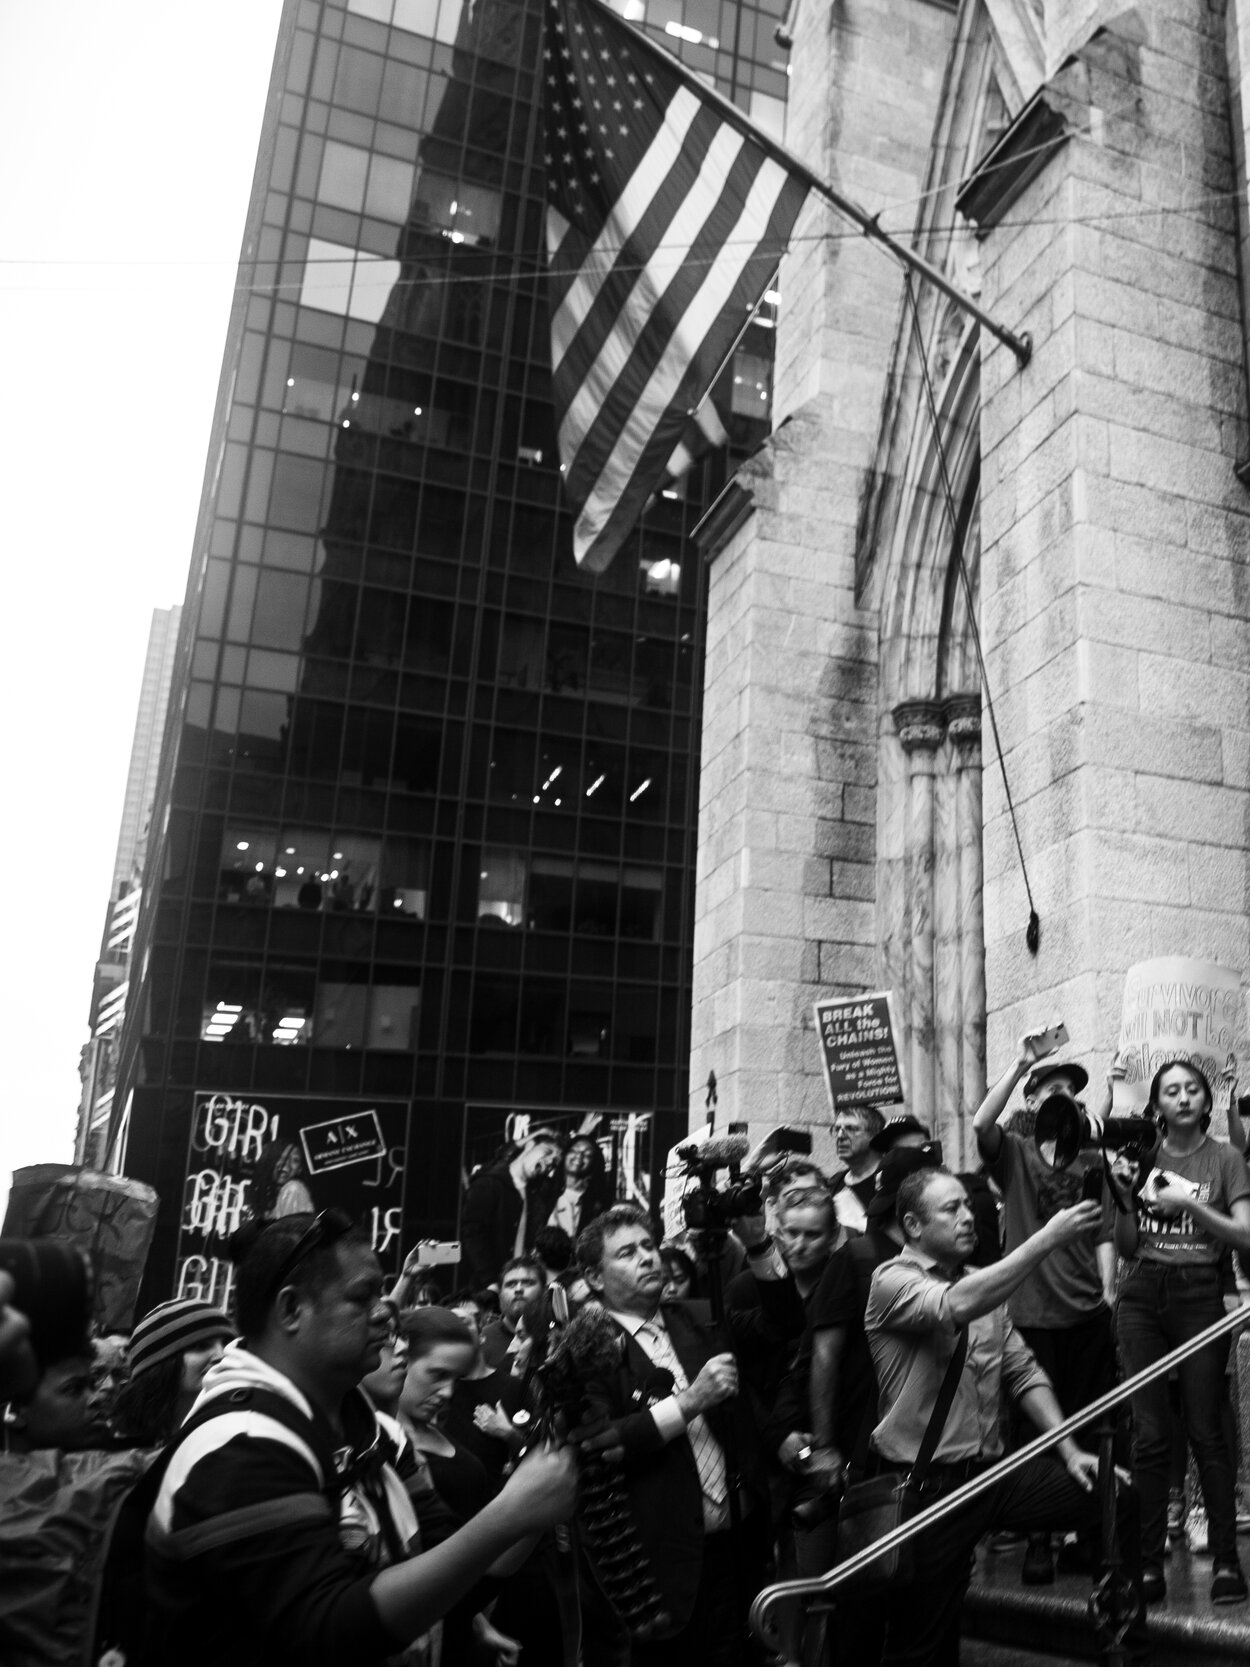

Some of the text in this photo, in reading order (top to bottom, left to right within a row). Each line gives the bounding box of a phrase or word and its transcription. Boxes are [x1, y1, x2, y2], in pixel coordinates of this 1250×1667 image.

[822, 1003, 873, 1023] BREAK
[824, 1018, 880, 1035] ALL the
[1152, 1009, 1204, 1041] NOT
[826, 1026, 888, 1048] CHAINS!
[839, 1048, 876, 1060] Unleash
[830, 1055, 894, 1073] Fury of Women
[845, 1072, 856, 1080] as
[866, 1065, 896, 1077] Mighty
[857, 1076, 898, 1088] Force for
[836, 1085, 900, 1102] REVOLUTION!
